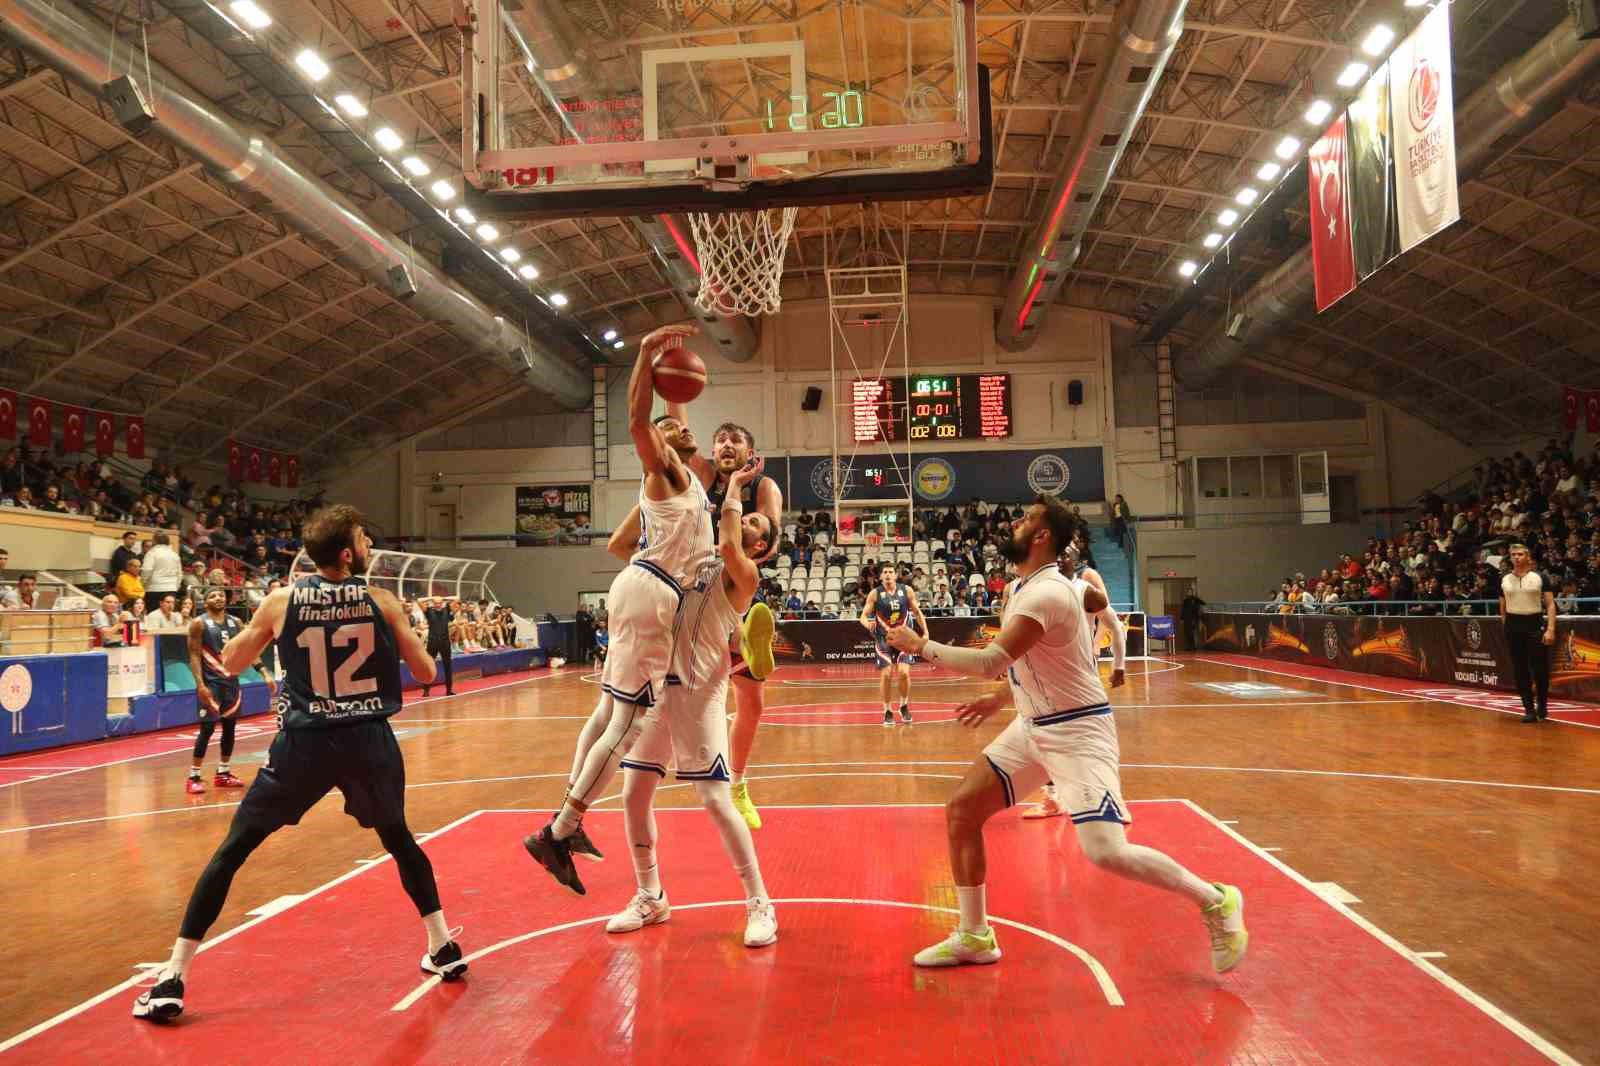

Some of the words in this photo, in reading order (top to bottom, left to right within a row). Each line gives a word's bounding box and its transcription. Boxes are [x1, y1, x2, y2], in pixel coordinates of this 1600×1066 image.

[911, 426, 930, 438] 002
[937, 425, 956, 437] 008
[890, 600, 900, 610] 15
[296, 622, 378, 698] 12
